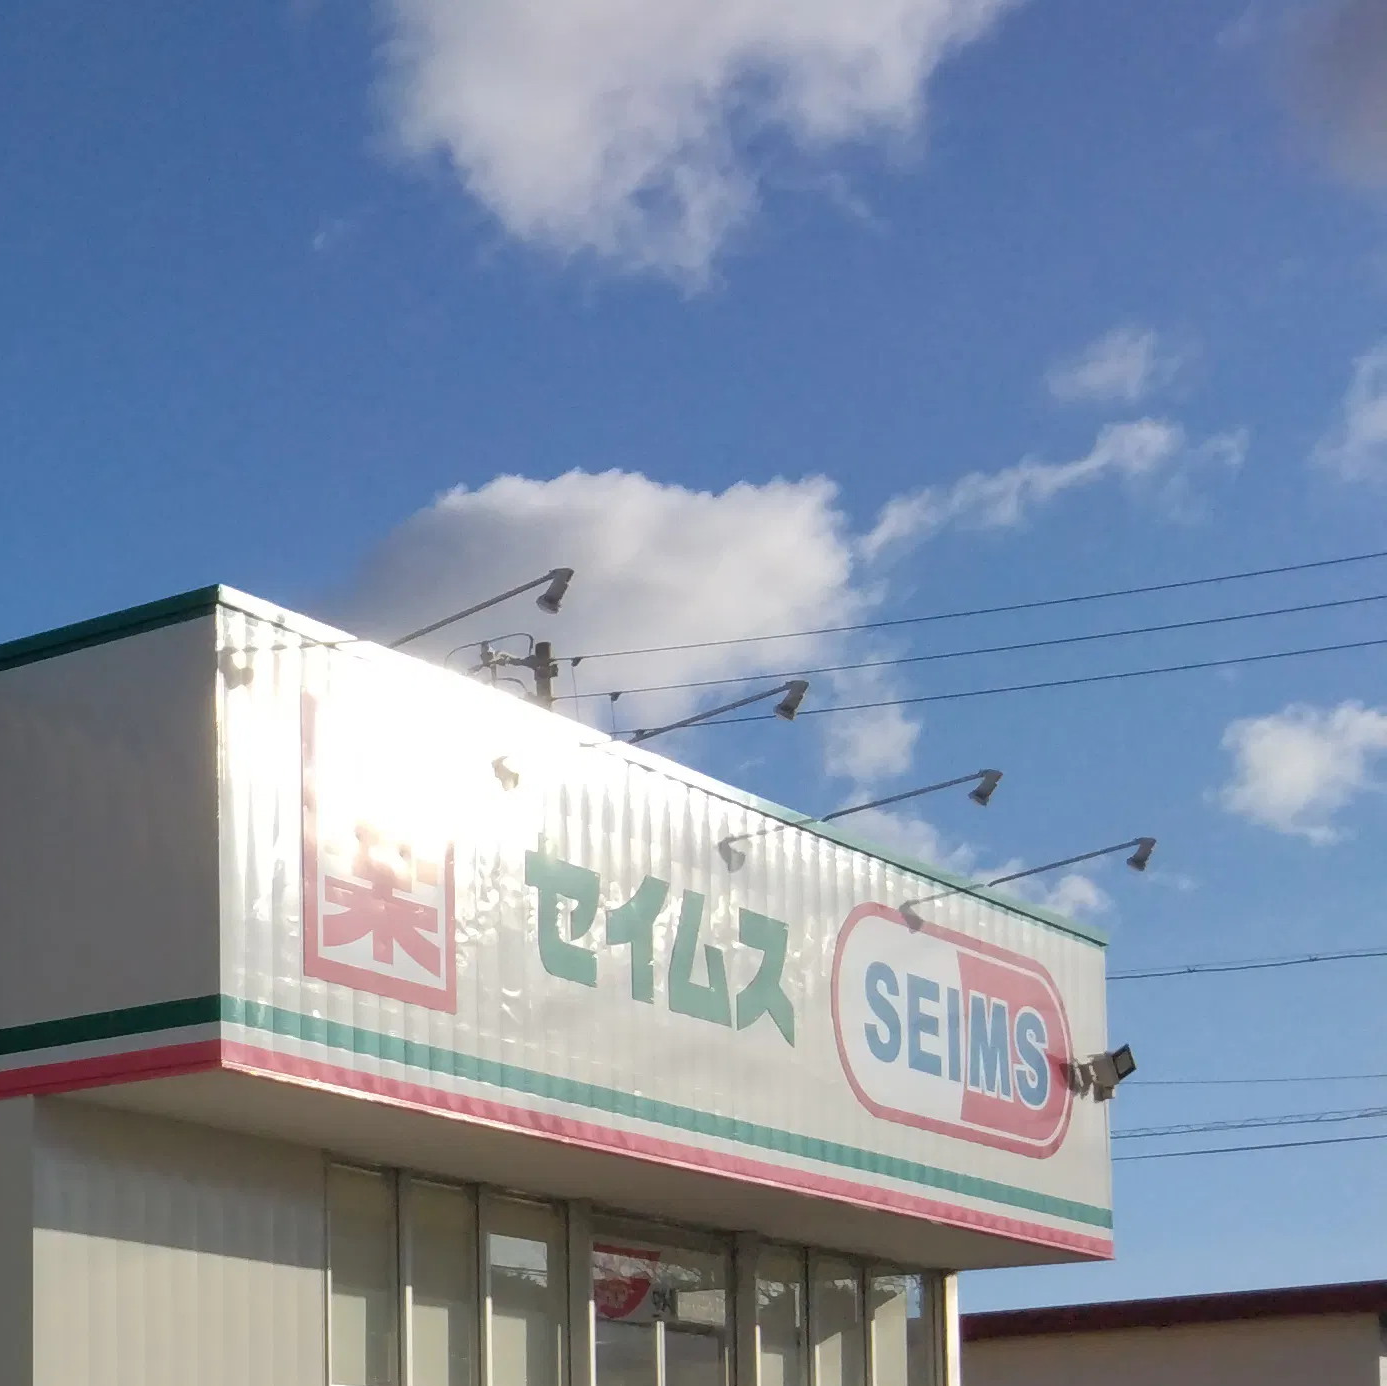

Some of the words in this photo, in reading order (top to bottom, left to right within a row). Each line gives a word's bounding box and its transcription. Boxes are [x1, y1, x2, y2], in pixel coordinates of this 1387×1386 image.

[525, 832, 795, 1048] セイムス
[863, 960, 1050, 1111] SEIMS
